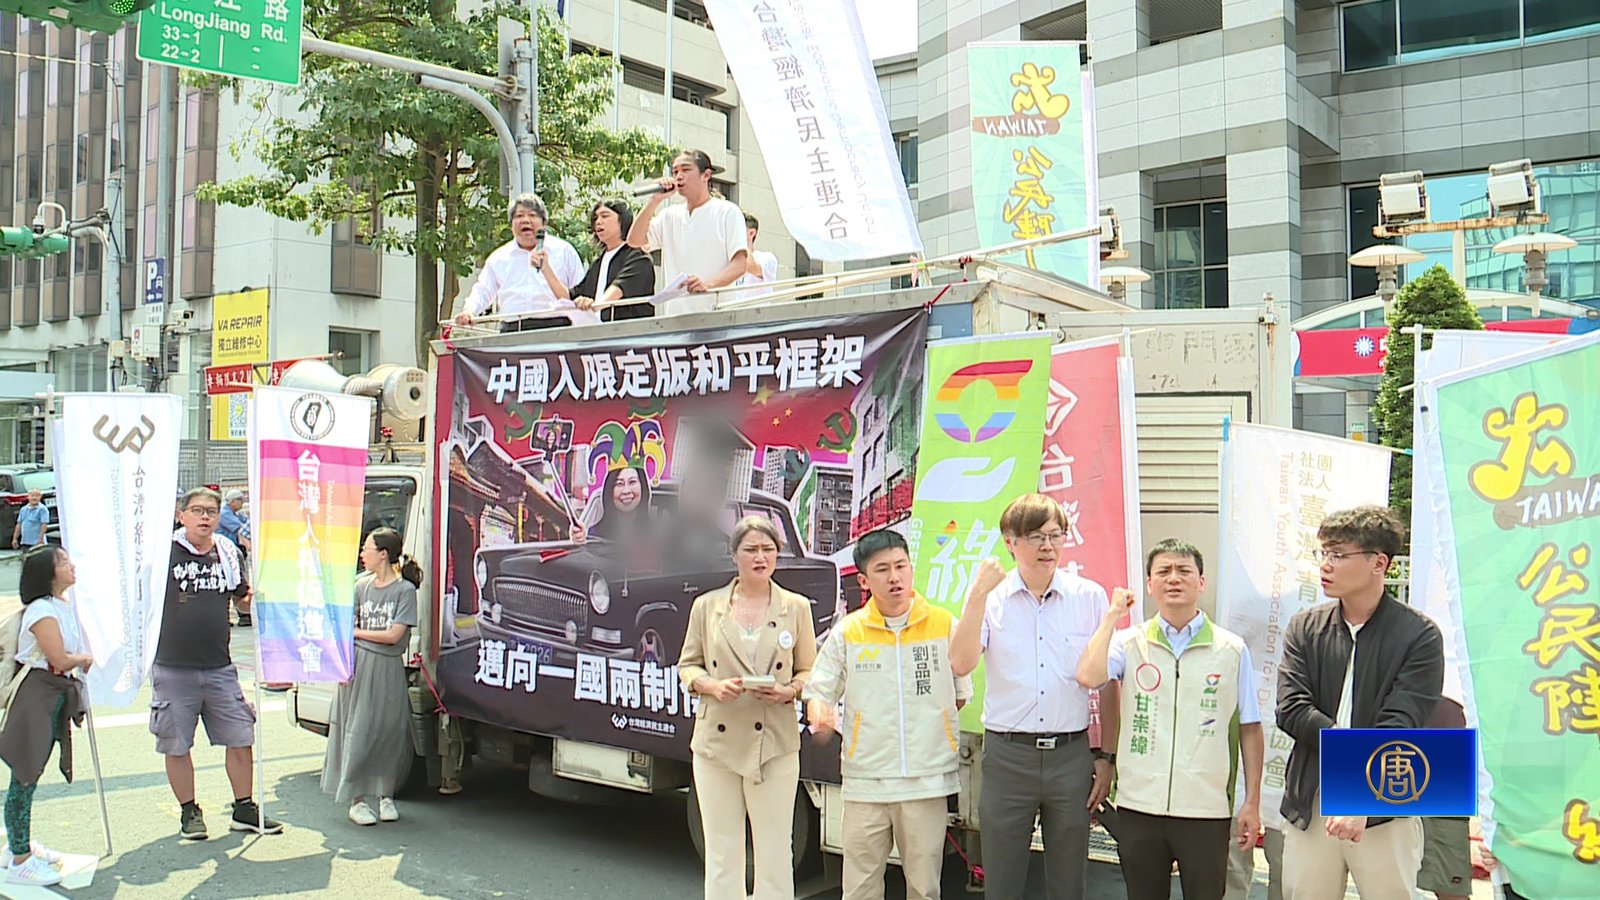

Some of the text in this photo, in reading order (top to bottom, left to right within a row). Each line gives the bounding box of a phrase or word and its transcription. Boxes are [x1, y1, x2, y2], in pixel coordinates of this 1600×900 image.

[160, 2, 288, 43] LongJiang Rd.
[161, 25, 201, 46] 33-1
[160, 43, 201, 63] 22-2
[147, 261, 158, 290] P
[229, 315, 263, 329] REPAIR
[486, 334, 866, 404] 中國人限定版和平框架
[1279, 451, 1294, 505] Taiwan
[1515, 477, 1600, 524] TAIWA
[908, 517, 924, 576] GREE
[1274, 512, 1291, 557] Youth
[926, 518, 1001, 604] 綠
[1265, 563, 1287, 654] Association
[912, 645, 932, 696] 劉品辰
[1129, 692, 1152, 755] 甘崇緯
